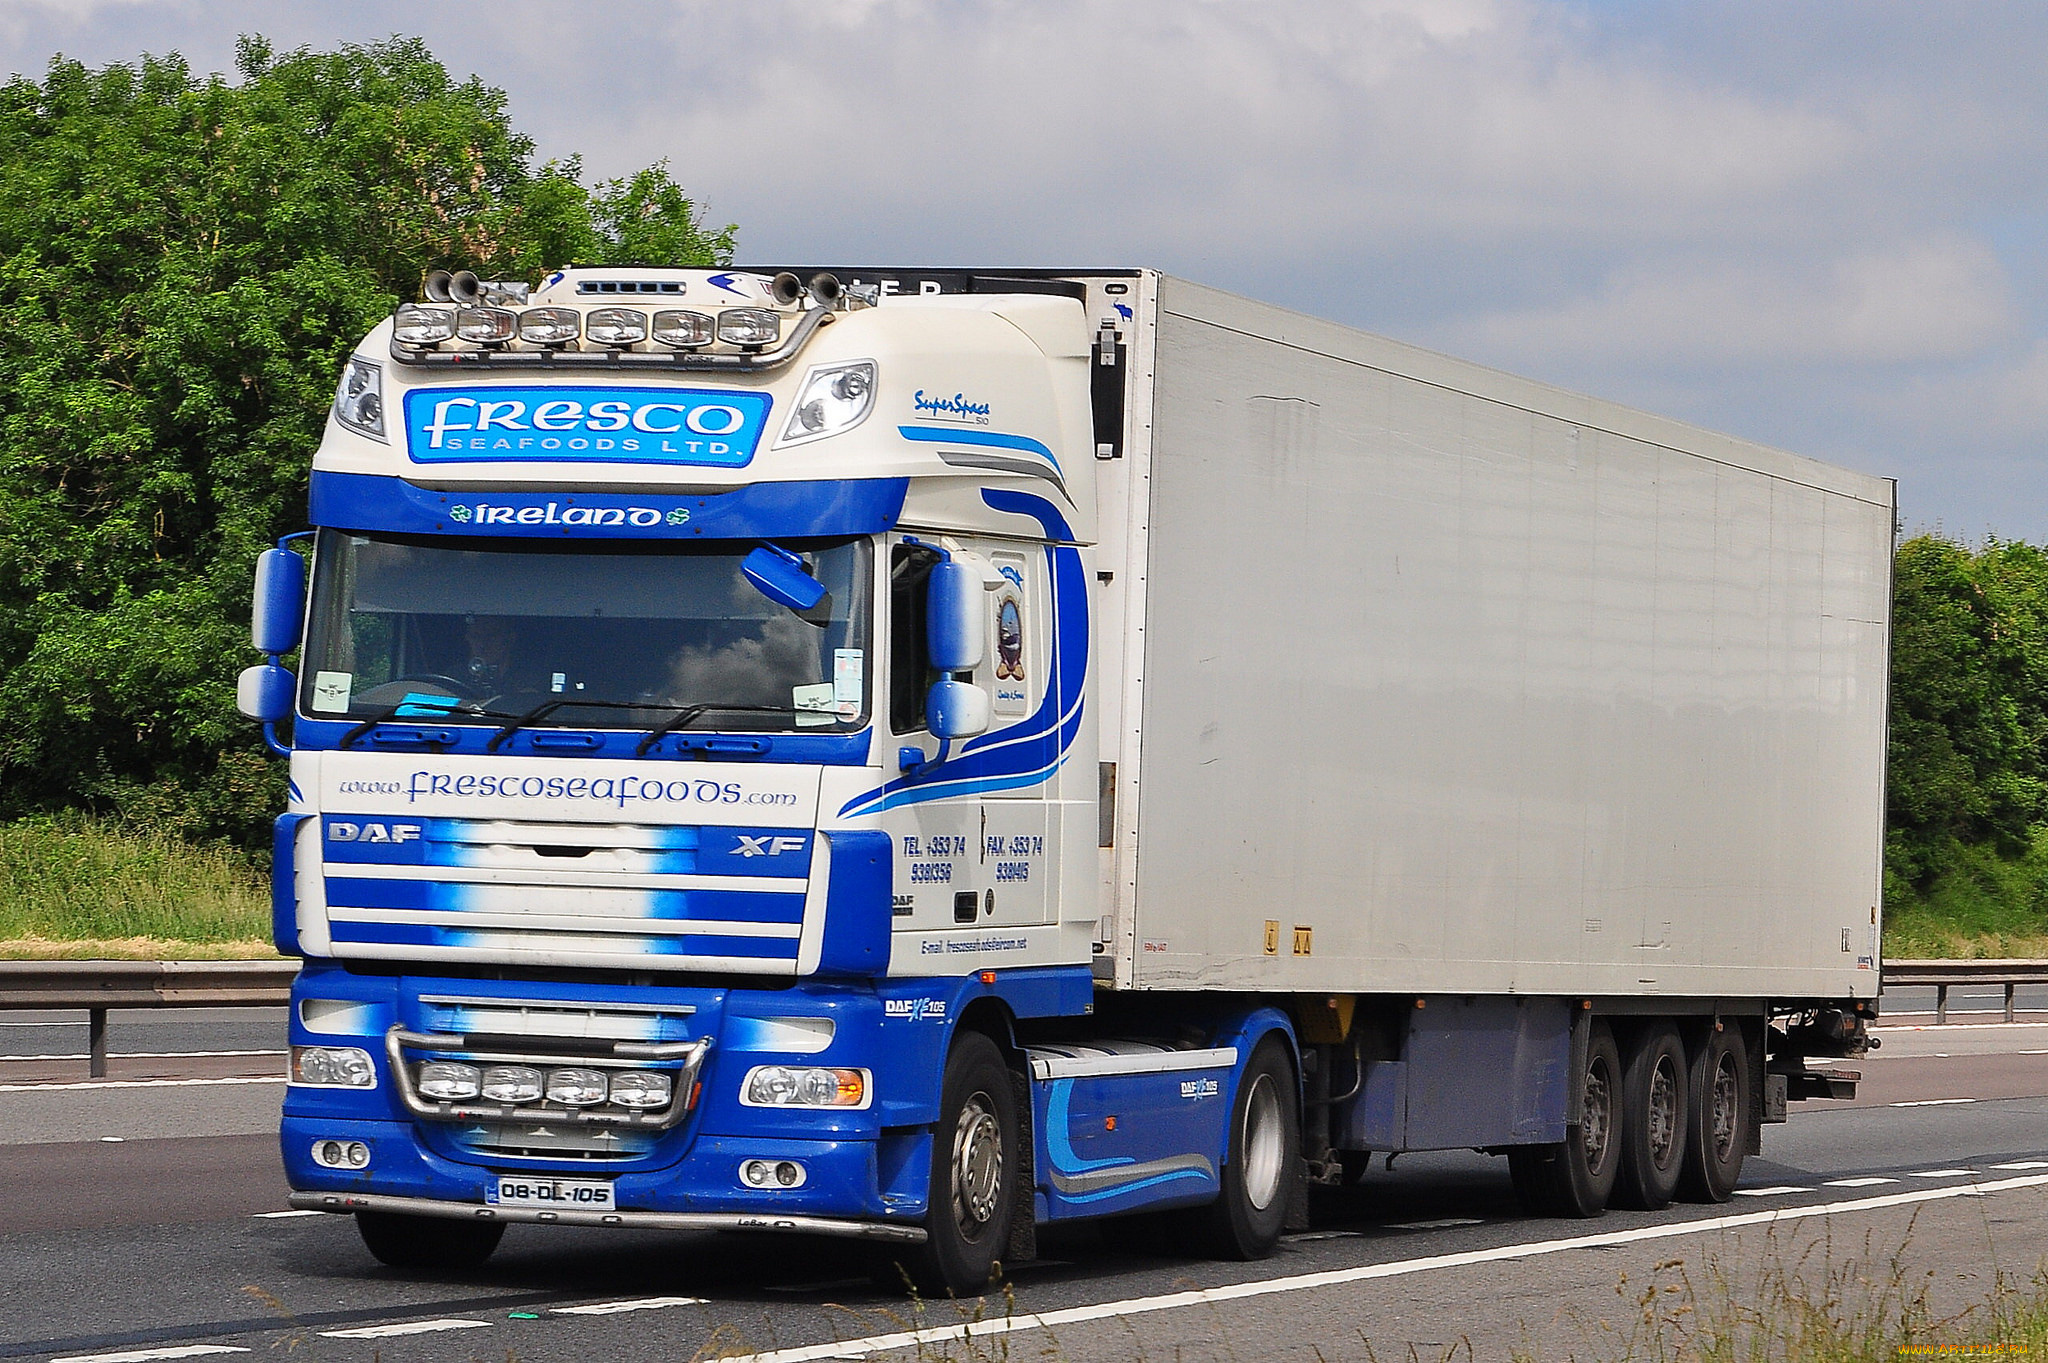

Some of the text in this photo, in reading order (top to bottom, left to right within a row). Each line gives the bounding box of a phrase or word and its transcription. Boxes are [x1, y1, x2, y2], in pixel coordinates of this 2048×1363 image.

[446, 437, 744, 456] SEAFOODS LTD.
[328, 822, 422, 843] DAF
[728, 835, 807, 857] XF
[953, 836, 966, 856] 74
[1032, 836, 1043, 856] 74
[501, 1182, 610, 1202] 08-DL-105
